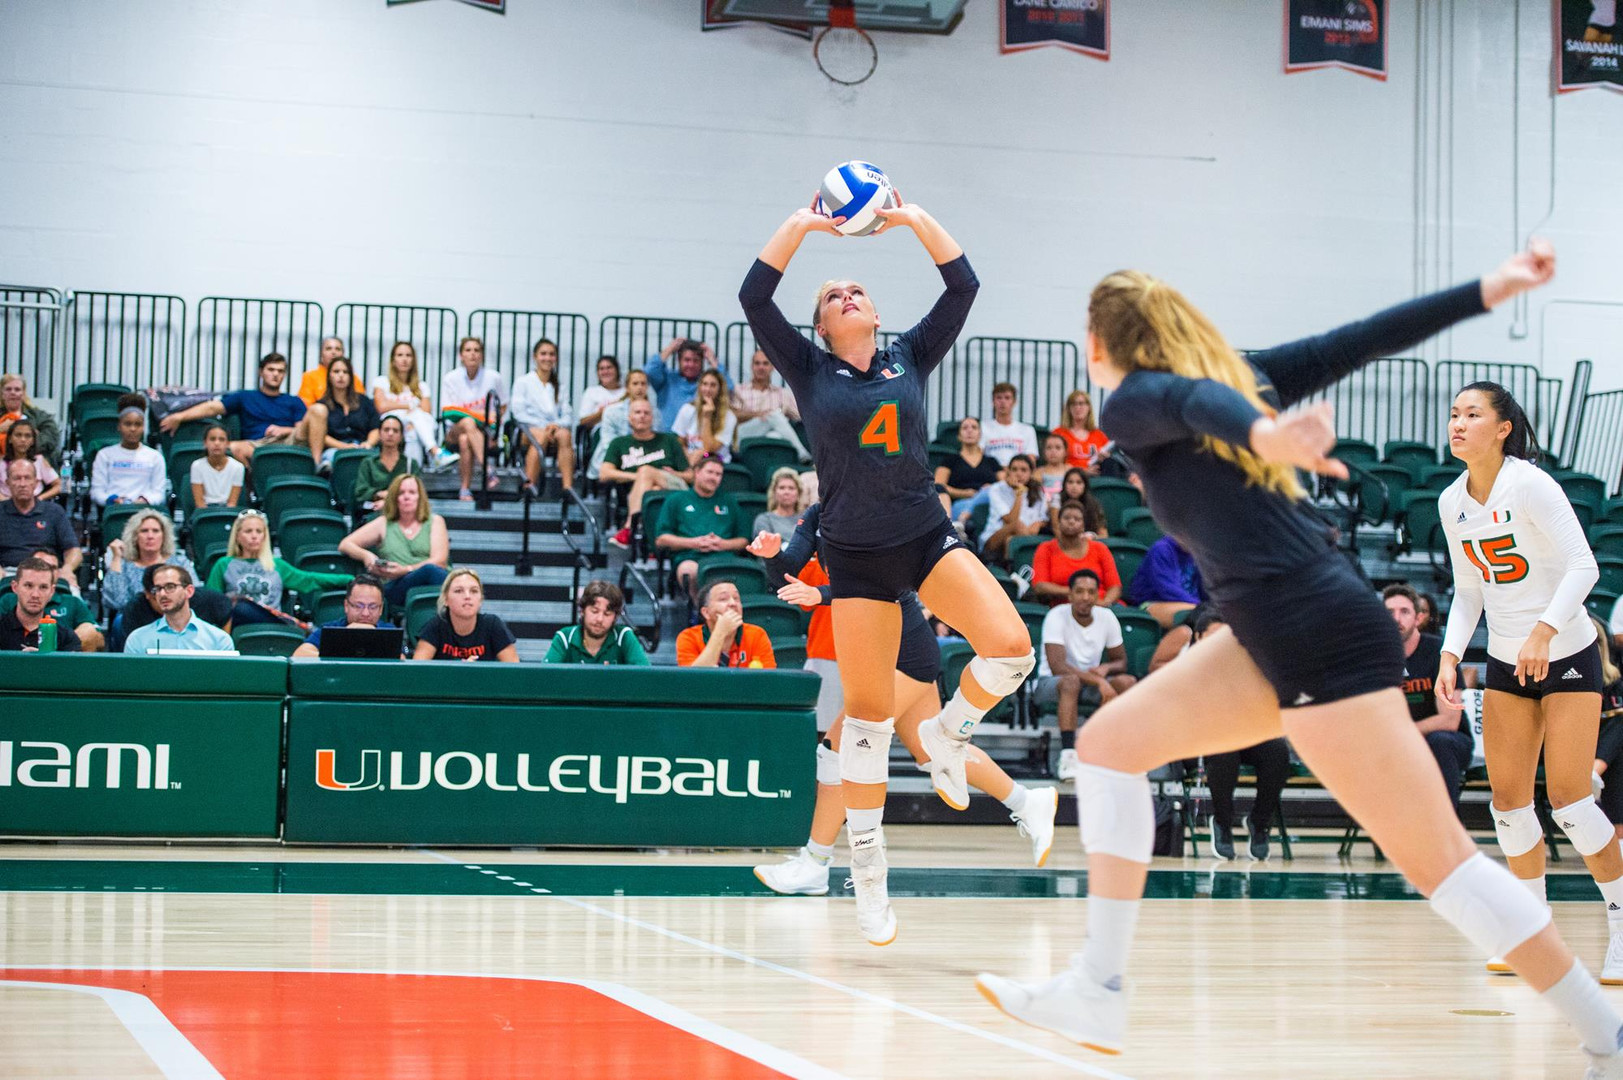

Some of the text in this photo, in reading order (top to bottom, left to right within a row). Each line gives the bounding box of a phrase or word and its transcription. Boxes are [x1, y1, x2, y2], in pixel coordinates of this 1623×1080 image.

[1344, 18, 1374, 32] SIMS
[858, 399, 902, 456] 4
[1461, 533, 1529, 584] 15
